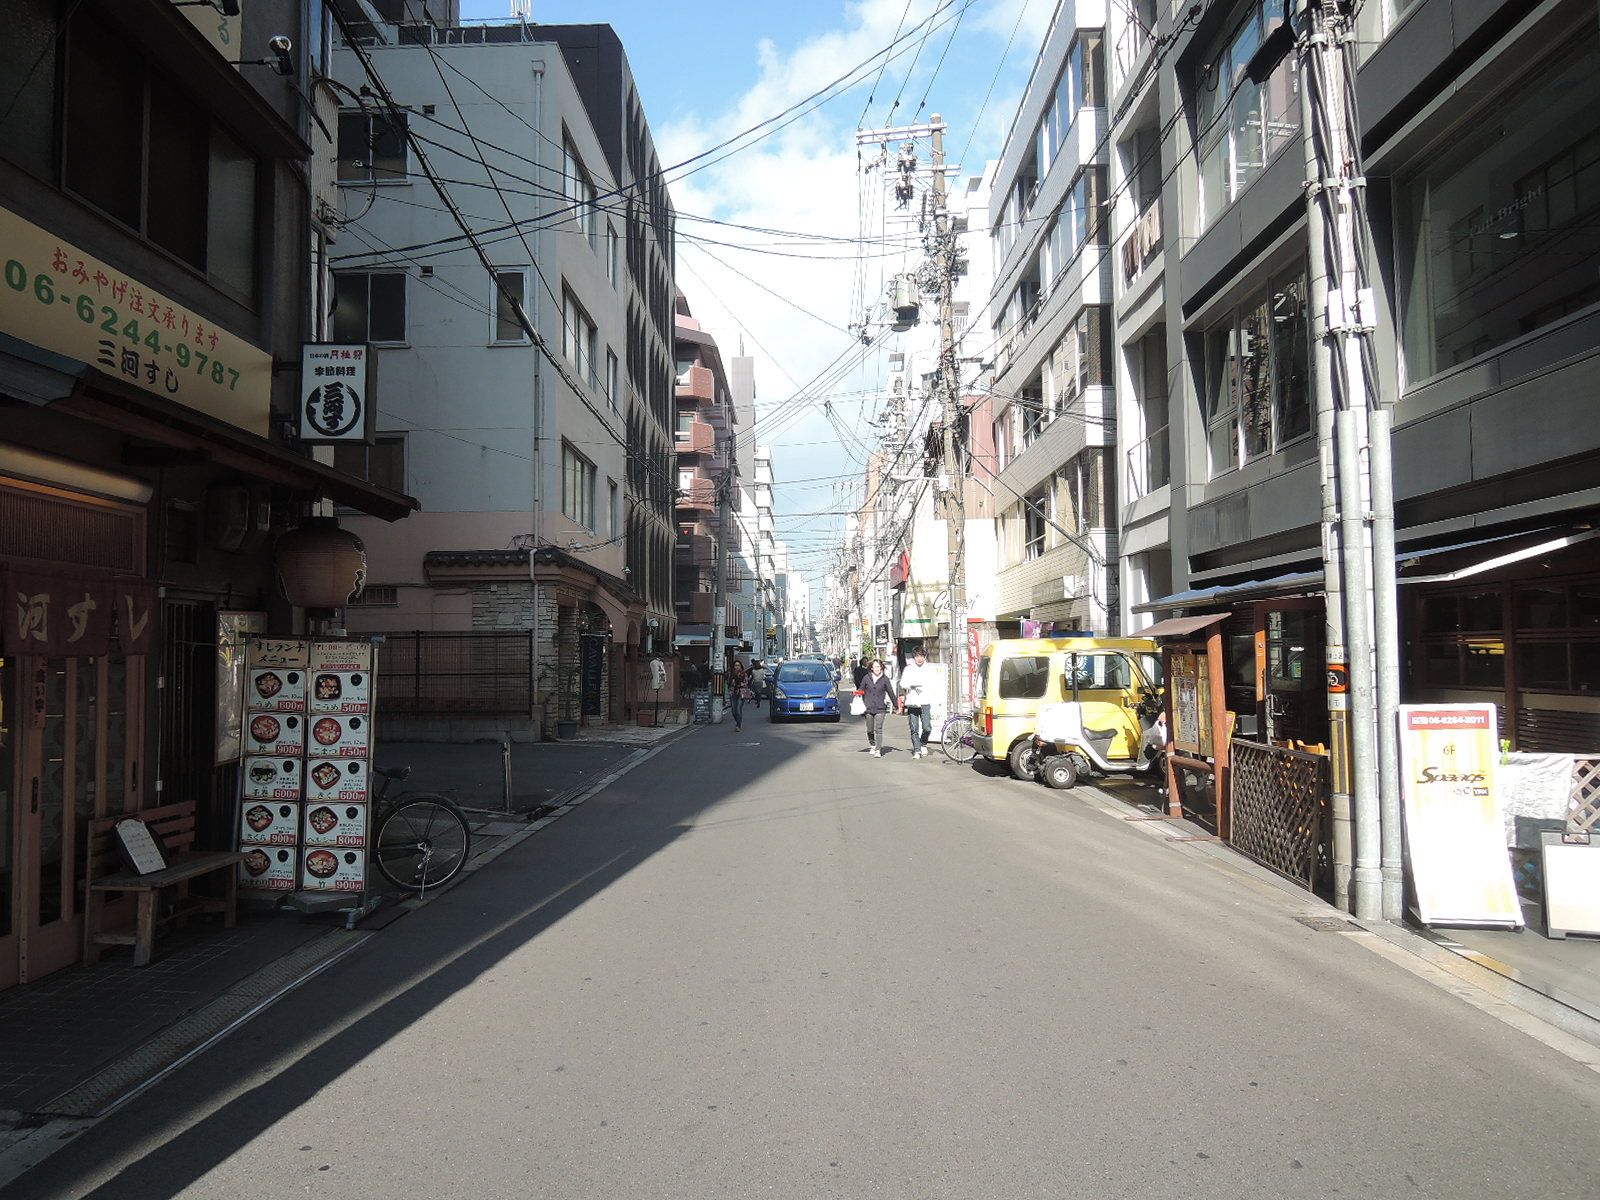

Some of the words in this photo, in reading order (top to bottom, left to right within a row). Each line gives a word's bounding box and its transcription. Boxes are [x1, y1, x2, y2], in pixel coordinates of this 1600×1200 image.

[1497, 185, 1542, 221] Bright
[52, 246, 219, 352] おみやげ注文承ります
[5, 259, 240, 391] 06-6244-9787
[97, 339, 179, 393] 三河すし
[255, 641, 305, 653] すしランチ
[258, 655, 299, 664] メニュー
[338, 836, 362, 845] 800円
